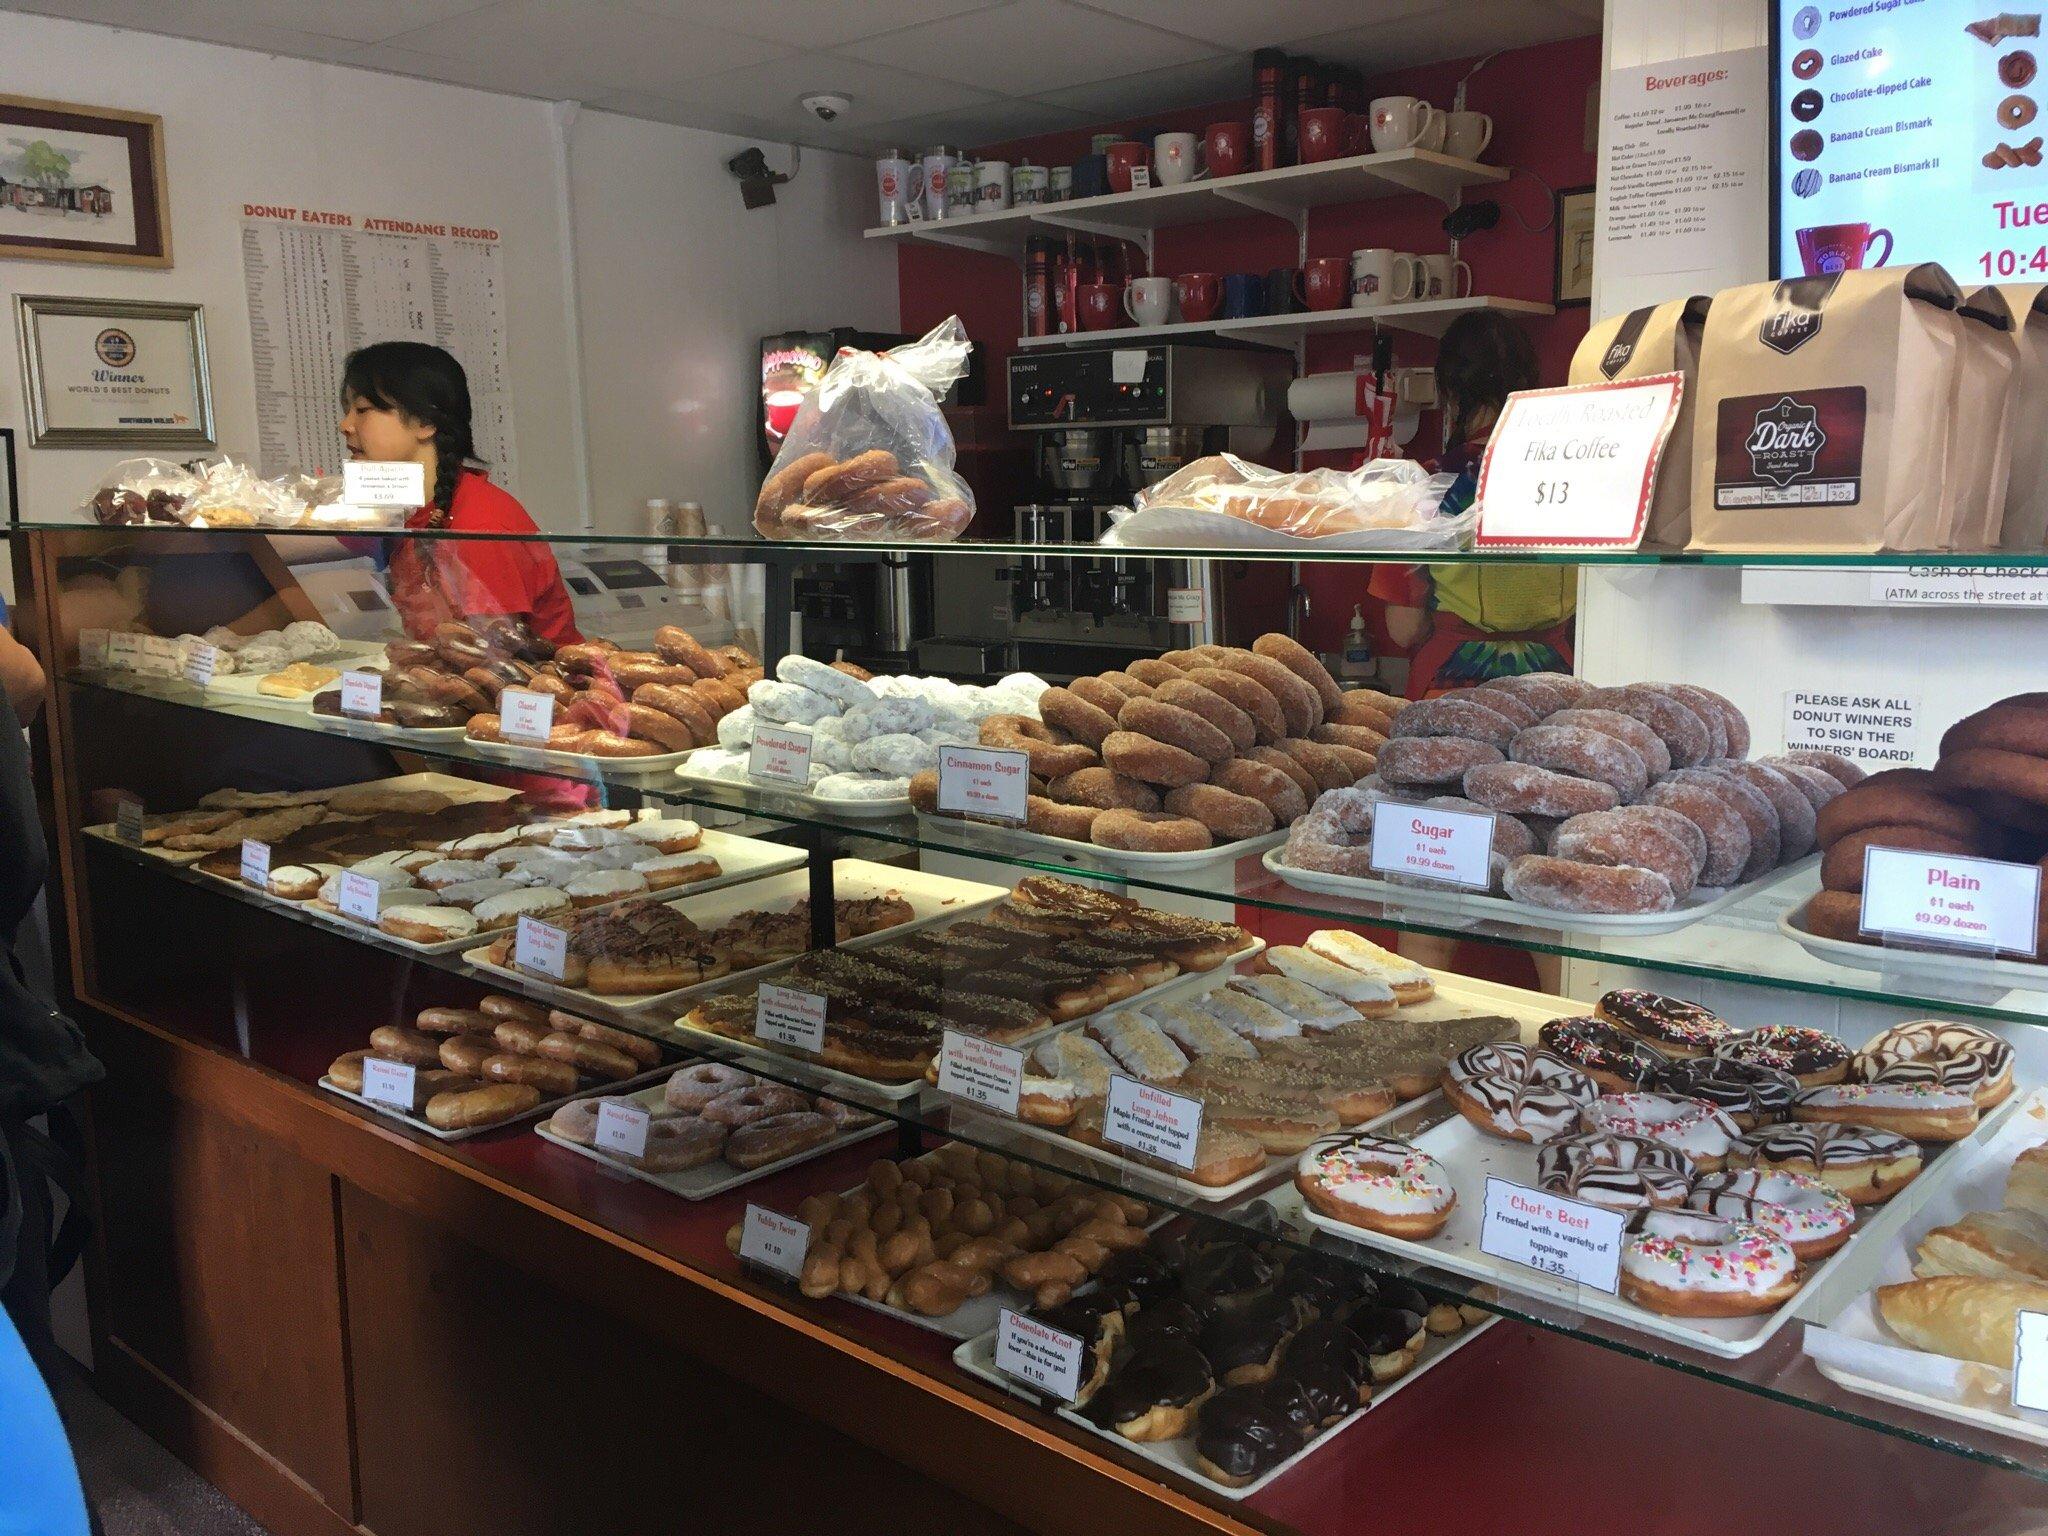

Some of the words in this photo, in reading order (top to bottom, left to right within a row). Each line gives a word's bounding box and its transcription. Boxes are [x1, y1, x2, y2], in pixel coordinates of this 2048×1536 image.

[1829, 2, 1873, 21] Powdered
[1830, 50, 1860, 66] Glazed
[1862, 47, 1883, 60] Cake
[1646, 69, 1728, 92] Beverages:
[1830, 80, 1908, 103] Chocolate-dipped
[1910, 76, 1932, 88] Cake
[1830, 124, 1864, 143] Banana
[1864, 121, 1894, 138] Cream
[1896, 116, 1933, 132] Bismark
[1828, 170, 1862, 184] Banana
[1864, 166, 1892, 178] Cream
[1894, 158, 1931, 174] Bismark
[1932, 158, 1940, 168] II
[244, 204, 296, 220] DONUT
[302, 210, 352, 226] EATERS
[364, 218, 446, 236] ATTENDANCE
[450, 226, 499, 241] RECORD
[1979, 246, 2048, 278] 10:4
[1772, 310, 1810, 332] fika
[1770, 327, 1808, 338] COFFEE
[92, 370, 146, 383] Winner
[1012, 364, 1038, 373] BUNN
[68, 386, 108, 394] WORLD'S
[111, 386, 132, 394] BEST
[134, 386, 170, 394] DONUTS
[1580, 396, 1655, 422] Roasted
[1750, 420, 1816, 452] Dark
[1777, 421, 1806, 432] Organic
[1524, 439, 1558, 462] Fika
[1563, 436, 1620, 461] Coffee
[1762, 450, 1806, 460] ROAST
[1534, 480, 1569, 506] $13
[1831, 490, 1852, 501] 302
[1908, 566, 1950, 578] Cash
[1957, 566, 1978, 578] or
[1984, 566, 2040, 578] Check
[1885, 588, 1918, 600] (ATM
[1921, 590, 1960, 600] across
[1964, 590, 1984, 600] the
[1988, 590, 2026, 600] street
[2030, 592, 2042, 600] at
[1795, 694, 1849, 707] PLEASE
[1851, 697, 1881, 708] ASK
[1884, 700, 1912, 710] ALL
[1793, 710, 1842, 723] DONUT
[1845, 713, 1912, 728] WINNERS
[756, 736, 786, 750] Powdered
[788, 742, 808, 754] Sugar
[1807, 727, 1826, 738] TO
[1829, 728, 1862, 741] SIGN
[1867, 731, 1895, 744] THE
[1858, 747, 1914, 762] BOARD!
[947, 756, 992, 772] Cinnamon
[994, 761, 1021, 776] Sugar
[1410, 818, 1454, 840] Sugar
[1416, 842, 1426, 852] $1
[1428, 846, 1446, 856] each
[1406, 856, 1430, 867] $9.99
[1432, 860, 1454, 870] dozen
[1927, 868, 1980, 891] Plain
[1930, 896, 1944, 908] $1
[1948, 901, 1974, 912] each
[1914, 912, 1950, 926] $9.99
[1953, 918, 1987, 931] dozen
[964, 1038, 980, 1052] Long
[982, 1044, 1003, 1058] Johns
[948, 1048, 964, 1060] with
[966, 1054, 988, 1067] vanilla
[989, 1060, 1017, 1078] frosting
[966, 1086, 987, 1100] $1.35
[1140, 1088, 1172, 1108] Unfilled
[1113, 1106, 1131, 1120] Maple
[1155, 1123, 1167, 1132] and
[1168, 1127, 1190, 1140] topped
[1132, 1102, 1151, 1117] Long
[1153, 1110, 1178, 1126] Johns
[1117, 1122, 1130, 1132] with
[1160, 1138, 1182, 1150] crunch
[1138, 1140, 1158, 1154] $1.35
[1510, 1195, 1552, 1220] Chef's
[1558, 1208, 1590, 1230] Best
[758, 1213, 777, 1231] Tubby
[779, 1222, 796, 1236] Twist
[1496, 1212, 1529, 1230] Frosted
[1531, 1224, 1551, 1236] with
[1562, 1234, 1595, 1251] variety
[1597, 1243, 1609, 1252] of
[1530, 1239, 1568, 1259] toppings
[1530, 1255, 1566, 1274] $1.35
[1010, 1314, 1050, 1340] Chocolate
[1052, 1332, 1072, 1350] Knot
[1012, 1332, 1016, 1340] If
[1017, 1336, 1034, 1348] you're
[1040, 1346, 1066, 1362] chocolate
[1024, 1365, 1044, 1381] $1.10
[1038, 1355, 1042, 1364] is
[1044, 1358, 1052, 1368] for
[1053, 1363, 1066, 1374] you!
